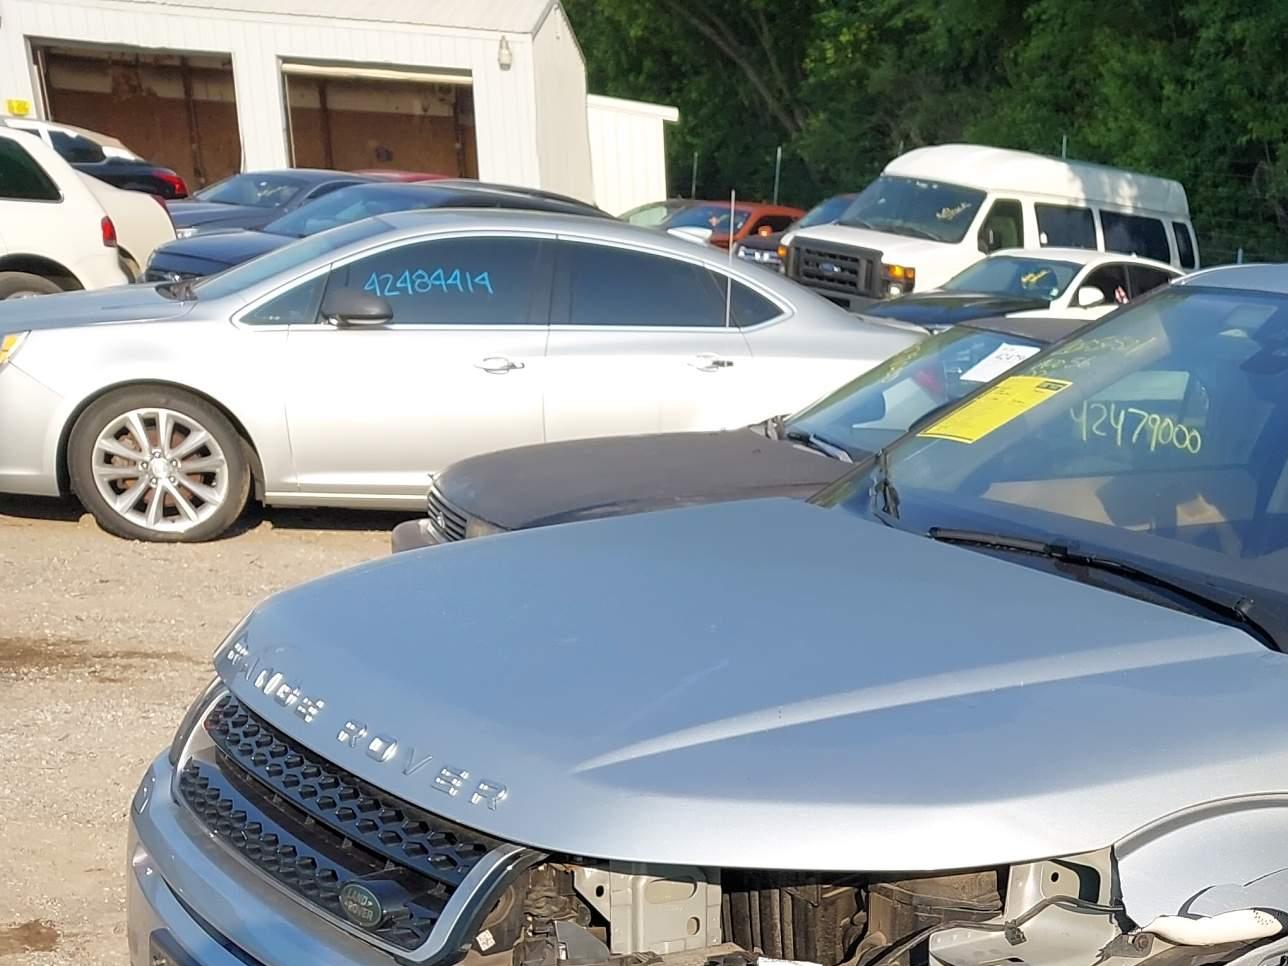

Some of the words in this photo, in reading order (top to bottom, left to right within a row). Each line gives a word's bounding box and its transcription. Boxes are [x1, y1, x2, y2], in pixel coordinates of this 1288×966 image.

[364, 267, 494, 297] 42484414
[1069, 399, 1202, 454] 42479000
[336, 719, 509, 811] ROVER
